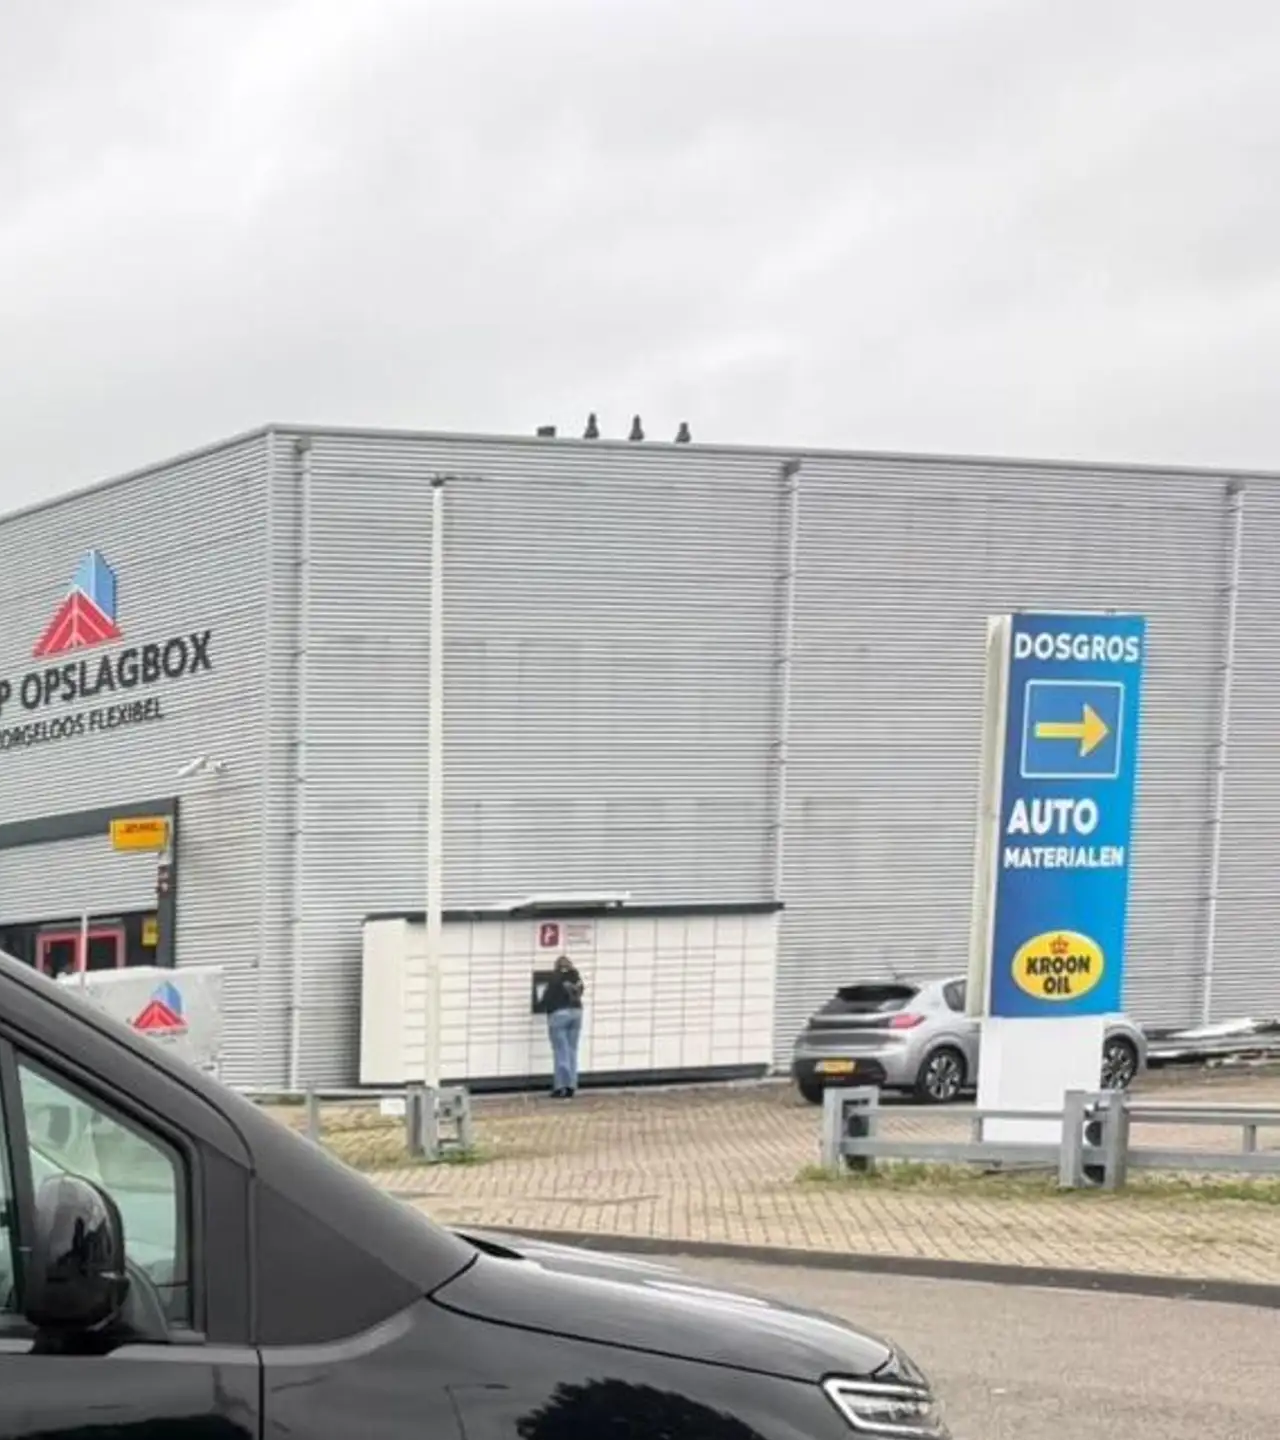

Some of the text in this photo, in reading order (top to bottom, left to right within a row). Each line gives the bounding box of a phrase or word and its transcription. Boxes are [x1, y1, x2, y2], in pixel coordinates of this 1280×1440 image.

[1014, 632, 1139, 663] DOSGROS
[20, 630, 212, 710] OPSLAGBOX
[90, 697, 164, 731] FLEXIBEL
[1006, 798, 1100, 835] AUTO
[1003, 846, 1125, 869] MATERIALEN
[1025, 955, 1092, 976] KROON
[1043, 976, 1072, 994] OIL
